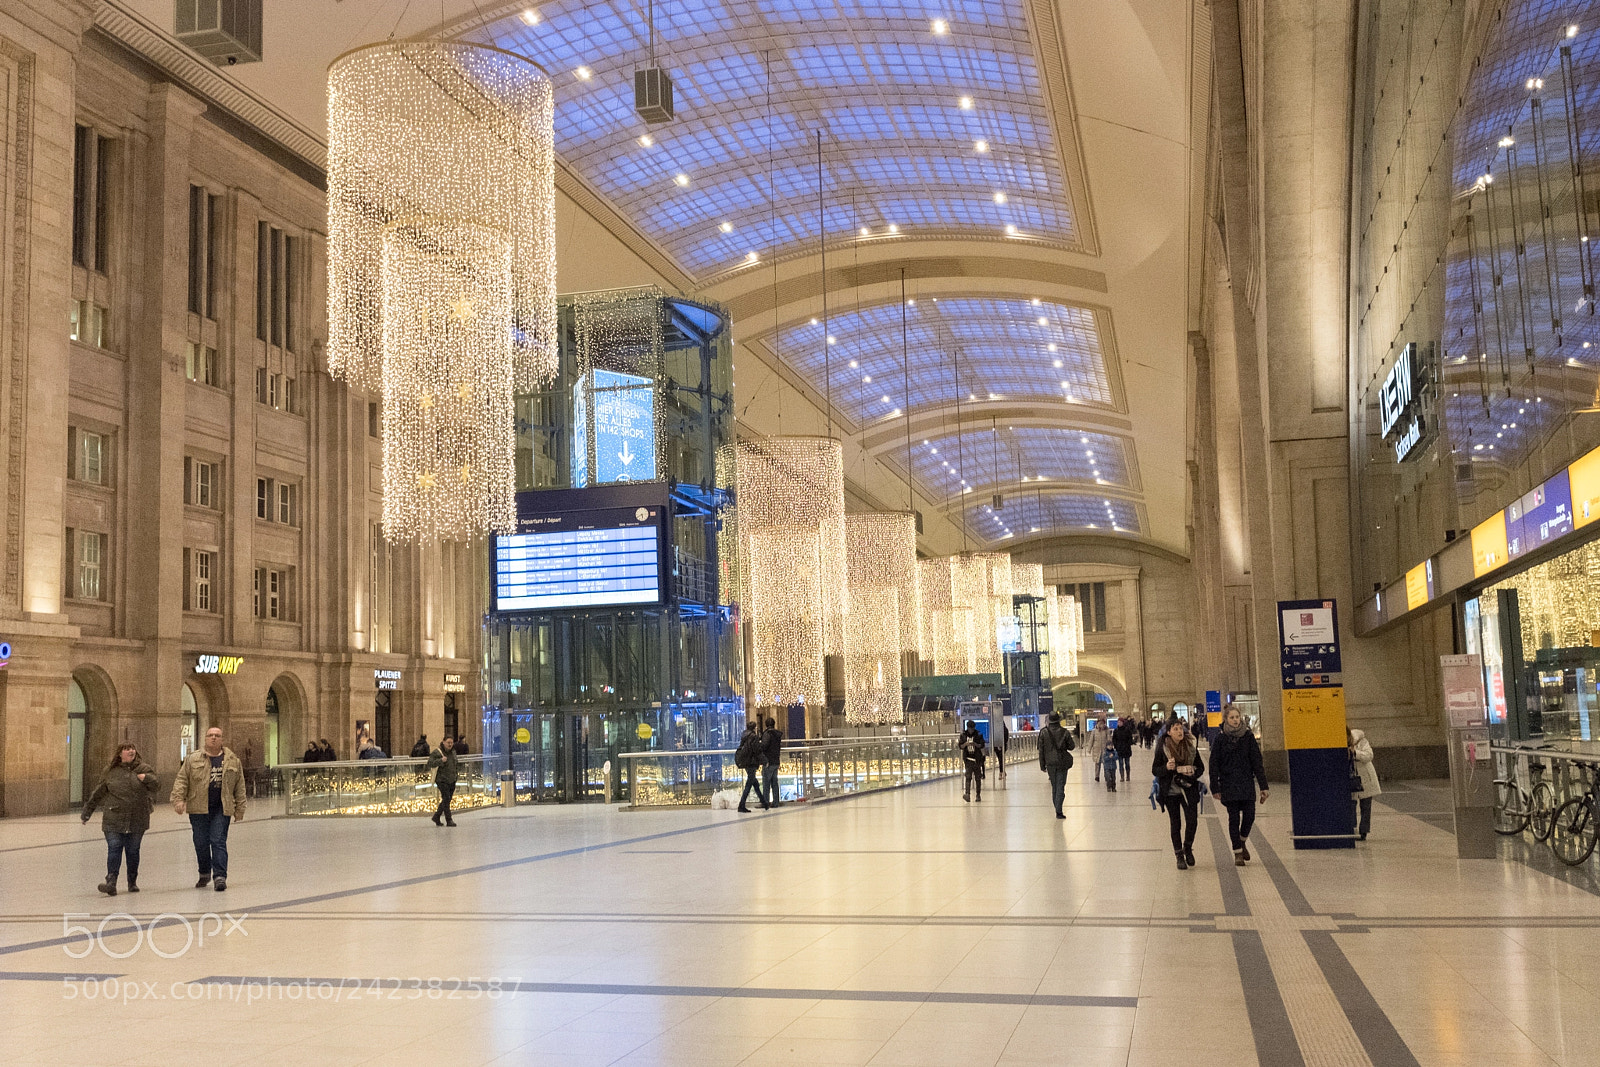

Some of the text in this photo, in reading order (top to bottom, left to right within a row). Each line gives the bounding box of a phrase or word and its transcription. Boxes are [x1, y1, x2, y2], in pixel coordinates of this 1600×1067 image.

[598, 404, 640, 419] HIER FINDEN
[598, 414, 632, 427] SIE ALLES
[598, 424, 644, 439] IN 142 SHOPS
[195, 655, 244, 674] SUBWAY
[374, 670, 401, 679] PLAUENER
[379, 681, 397, 689] SPITZE
